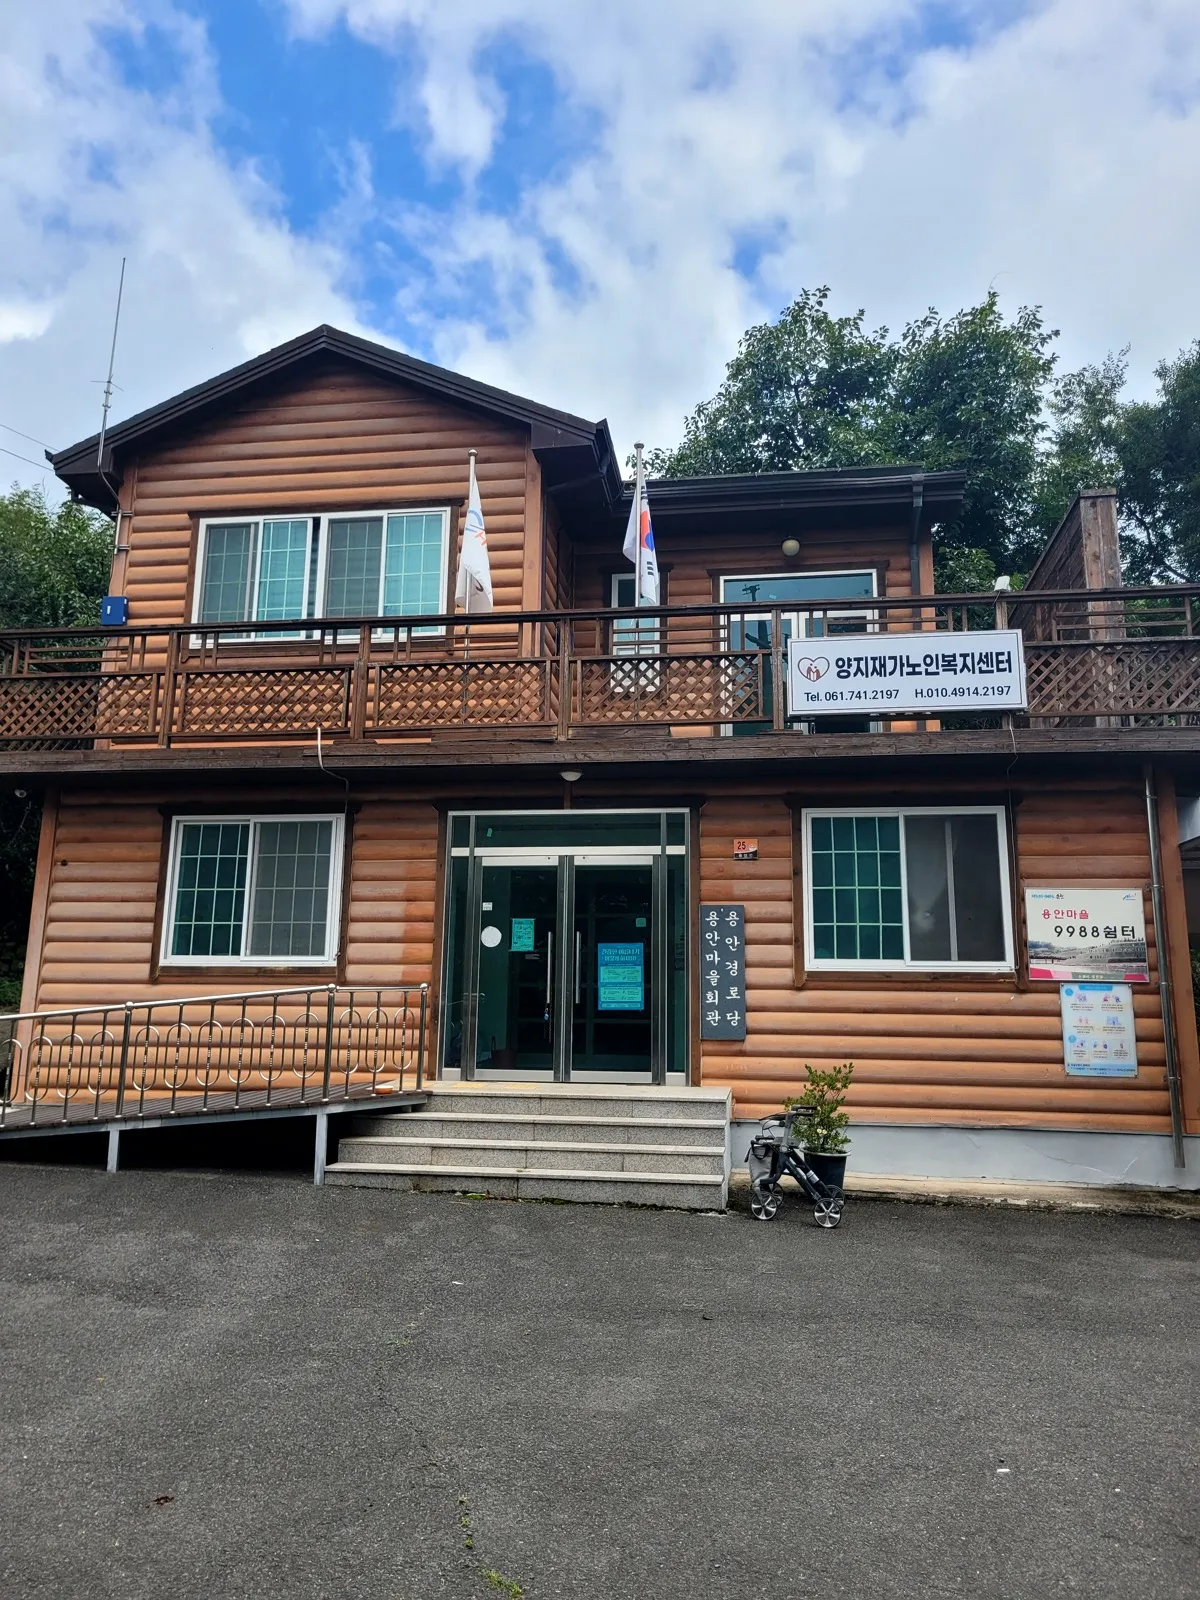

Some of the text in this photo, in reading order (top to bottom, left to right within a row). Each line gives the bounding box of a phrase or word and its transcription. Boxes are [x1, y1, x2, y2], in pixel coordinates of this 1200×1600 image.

[835, 651, 1012, 679] 양지재가노인복지센터
[804, 685, 1011, 702] Tel. 061.741.2197 H.010.4914.2197
[737, 841, 746, 850] 25
[1042, 908, 1089, 920] 용안마을
[1054, 925, 1136, 939] 9988쉼터
[705, 911, 721, 1026] 용안마을회관
[725, 911, 741, 1026] 용안경로당
